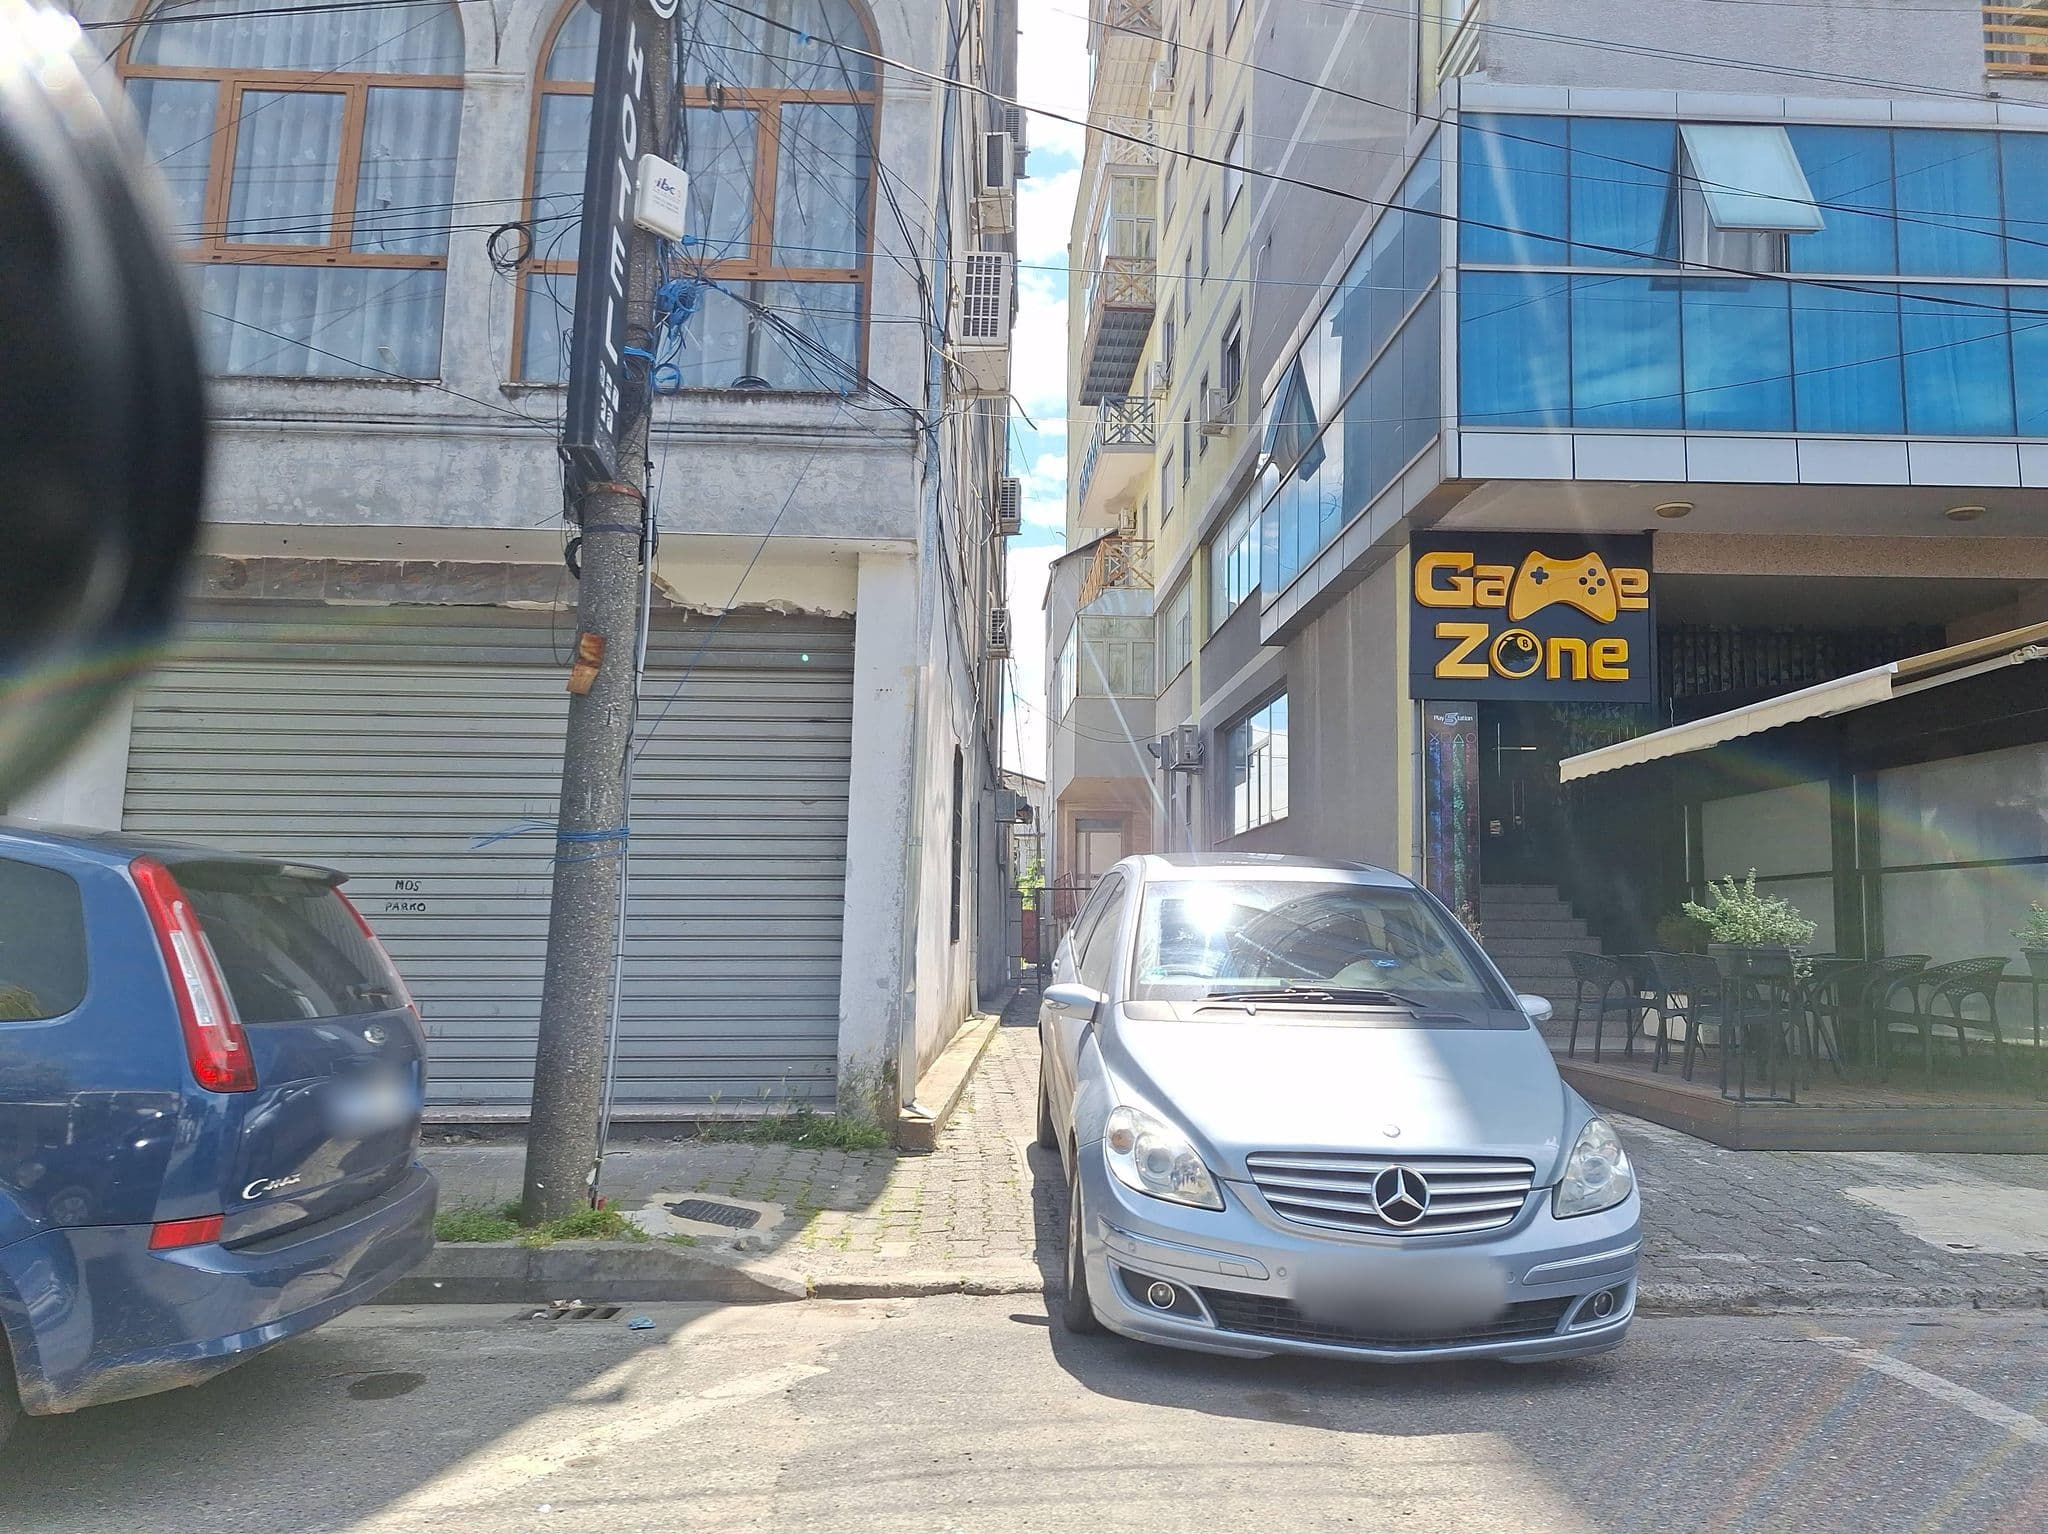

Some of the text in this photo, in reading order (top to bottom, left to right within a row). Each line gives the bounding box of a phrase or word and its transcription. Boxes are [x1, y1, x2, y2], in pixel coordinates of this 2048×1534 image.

[605, 20, 644, 366] HOTEL
[395, 880, 422, 891] MOS
[385, 902, 426, 913] PARKO
